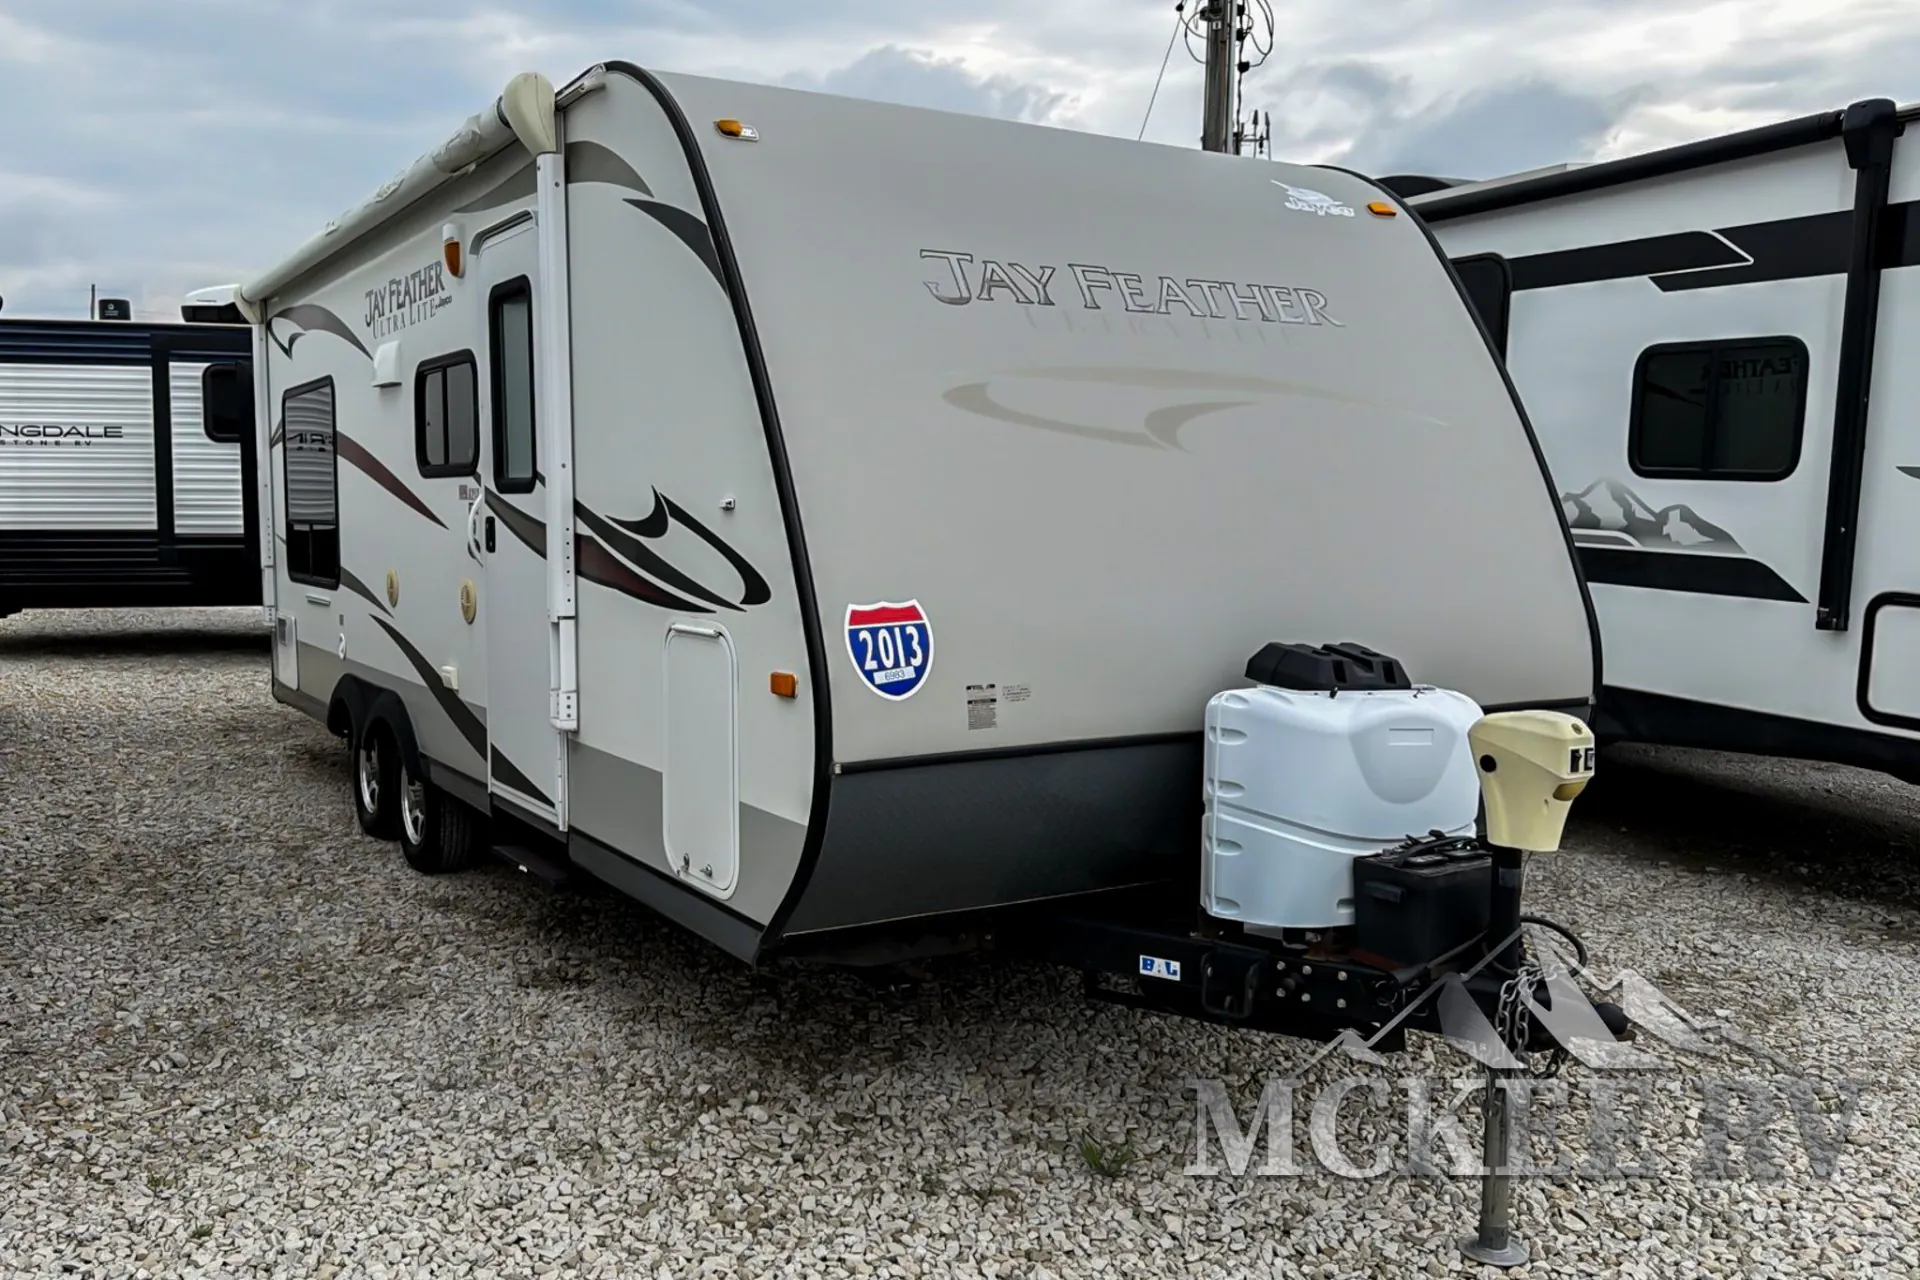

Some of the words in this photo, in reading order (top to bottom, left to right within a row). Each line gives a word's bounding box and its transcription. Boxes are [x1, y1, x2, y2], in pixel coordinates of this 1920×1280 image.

[364, 286, 387, 328] JAY
[388, 260, 445, 314] FEATHER
[920, 249, 1056, 306] JAY
[1067, 263, 1347, 327] FEATHER
[373, 311, 406, 340] ULTRA
[410, 298, 437, 326] LITE
[0, 424, 123, 438] NGDALE
[858, 625, 923, 671] 2013
